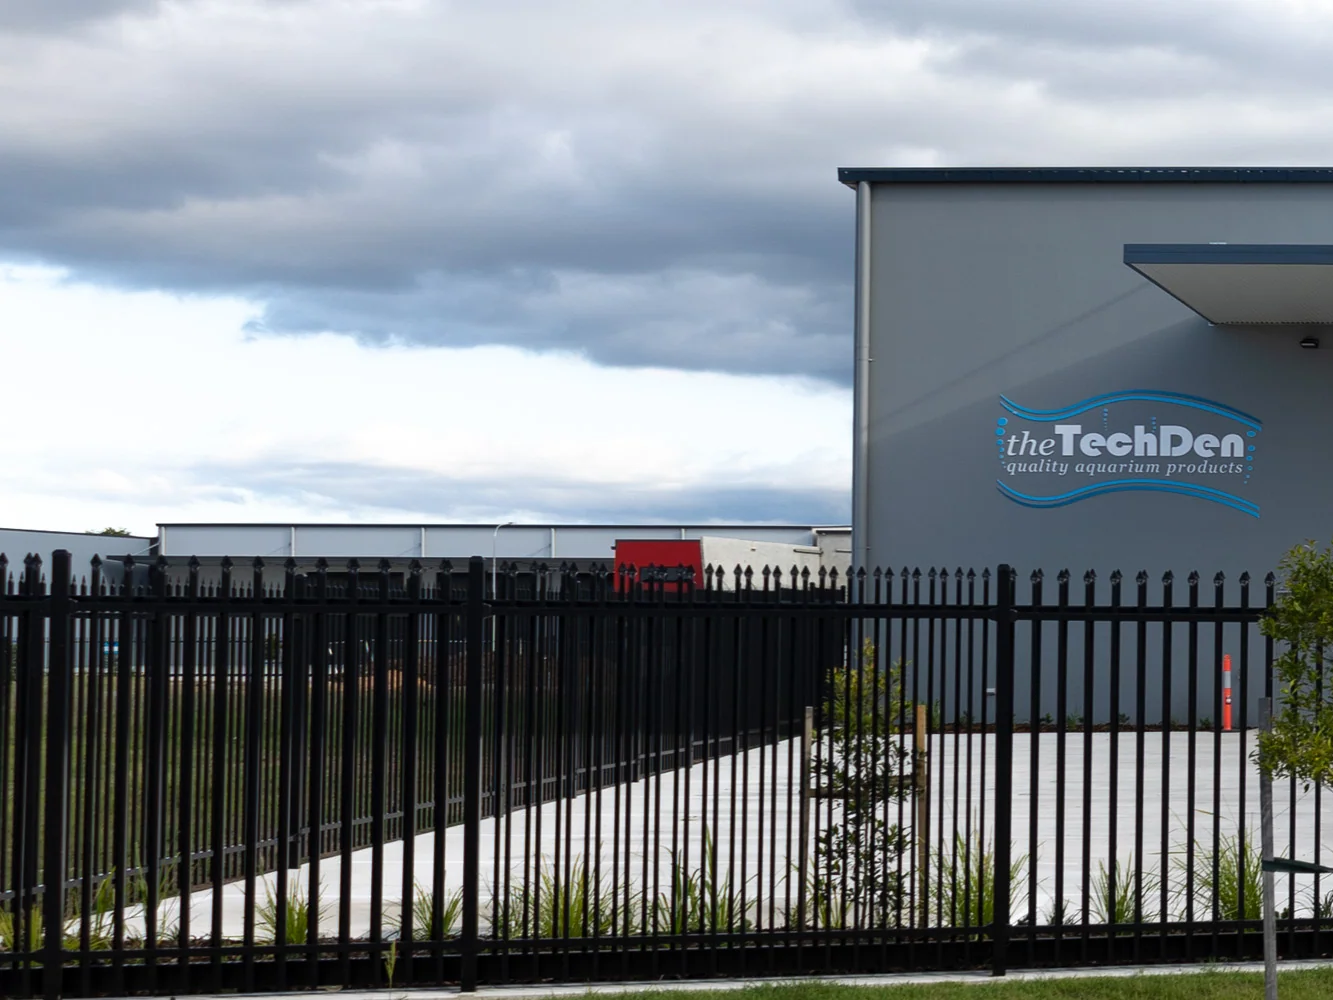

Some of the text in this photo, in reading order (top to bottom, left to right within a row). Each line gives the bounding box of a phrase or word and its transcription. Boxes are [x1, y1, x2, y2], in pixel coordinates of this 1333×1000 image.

[1006, 459, 1243, 476] quality aquarium products
